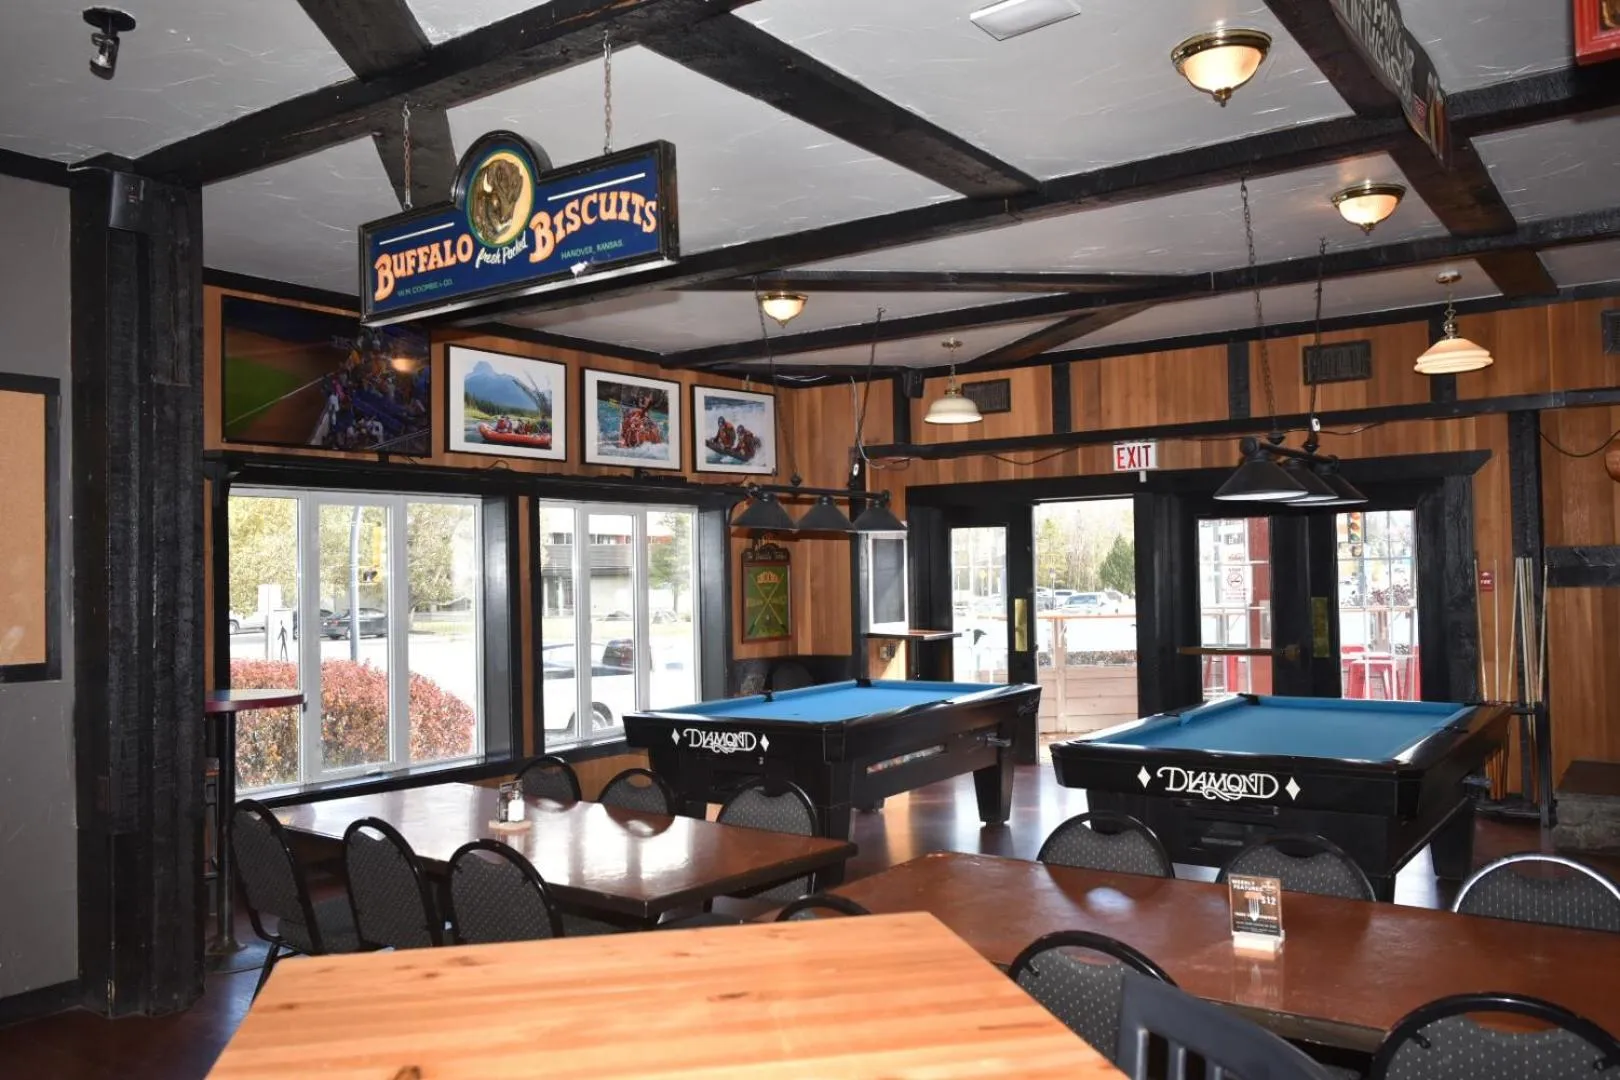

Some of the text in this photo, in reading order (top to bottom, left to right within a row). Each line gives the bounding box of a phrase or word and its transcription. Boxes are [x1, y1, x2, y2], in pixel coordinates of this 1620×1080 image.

[374, 191, 657, 301] BUFFALO BISCUITS
[1117, 445, 1151, 469] EXIT
[683, 728, 757, 754] DIAMOND
[1156, 766, 1279, 802] DIAMOND
